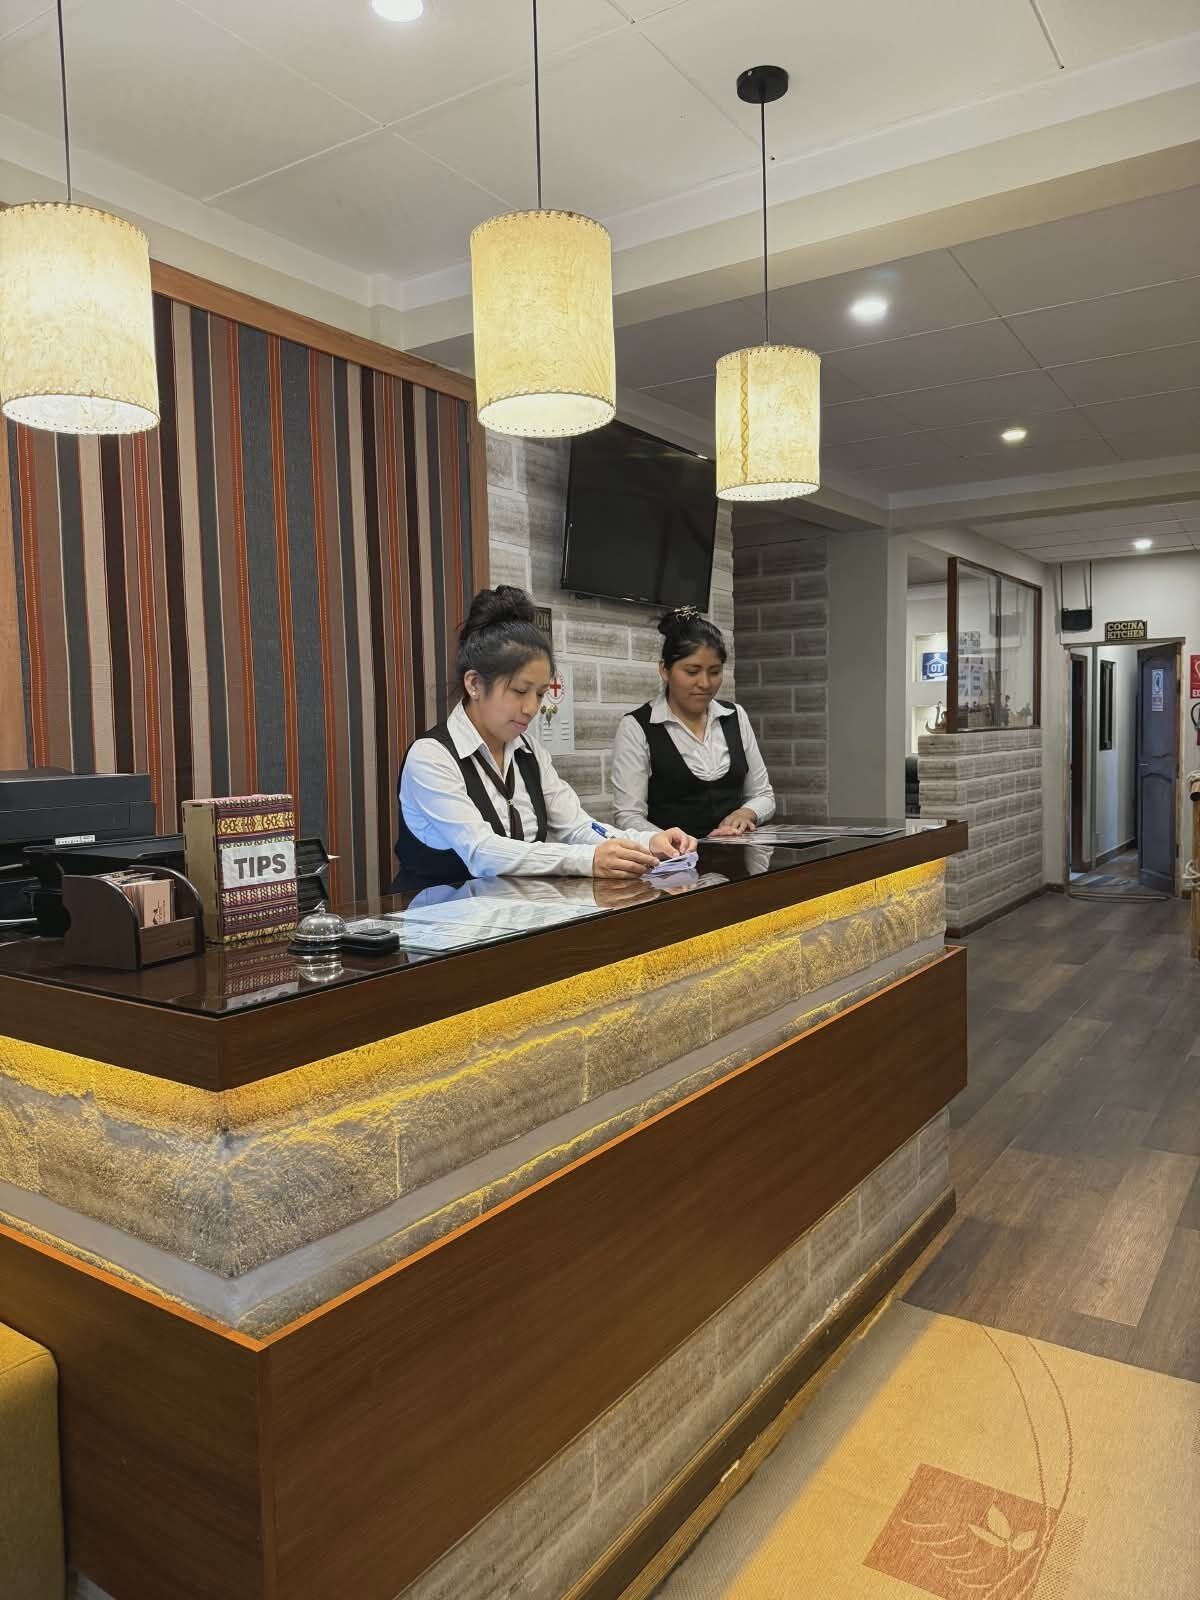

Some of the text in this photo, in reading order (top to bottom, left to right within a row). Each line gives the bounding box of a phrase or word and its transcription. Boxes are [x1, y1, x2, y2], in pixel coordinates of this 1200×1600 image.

[1107, 622, 1145, 631] COCINA
[1107, 630, 1145, 639] KITCHEN
[233, 853, 287, 880] TIPS
